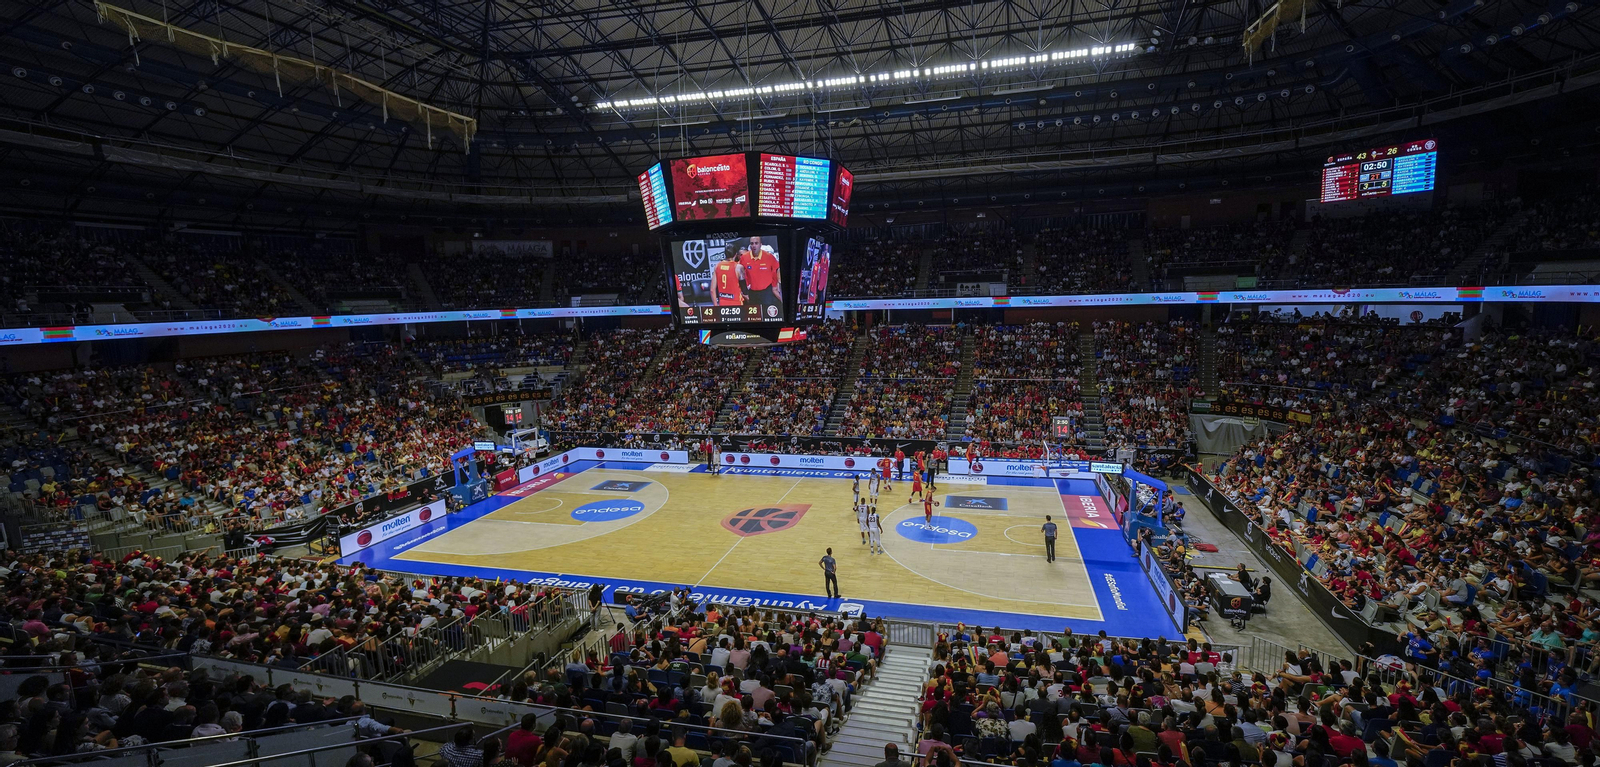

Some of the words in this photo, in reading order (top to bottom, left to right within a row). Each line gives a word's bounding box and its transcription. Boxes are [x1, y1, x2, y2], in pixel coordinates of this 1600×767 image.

[1357, 152, 1367, 160] 43
[1387, 147, 1398, 155] 26
[697, 164, 730, 173] baloncesto
[1363, 161, 1387, 171] 02:50
[722, 274, 727, 289] 9
[704, 308, 713, 316] 43
[1224, 405, 1238, 413] es
[1241, 406, 1254, 414] es
[1258, 408, 1270, 416] es
[1057, 426, 1068, 434] 14
[723, 466, 829, 476] Ayuntamiento
[506, 478, 552, 496] IBERIA
[575, 505, 642, 514] endesa
[1079, 496, 1100, 518] IBERIA
[382, 514, 411, 533] molten
